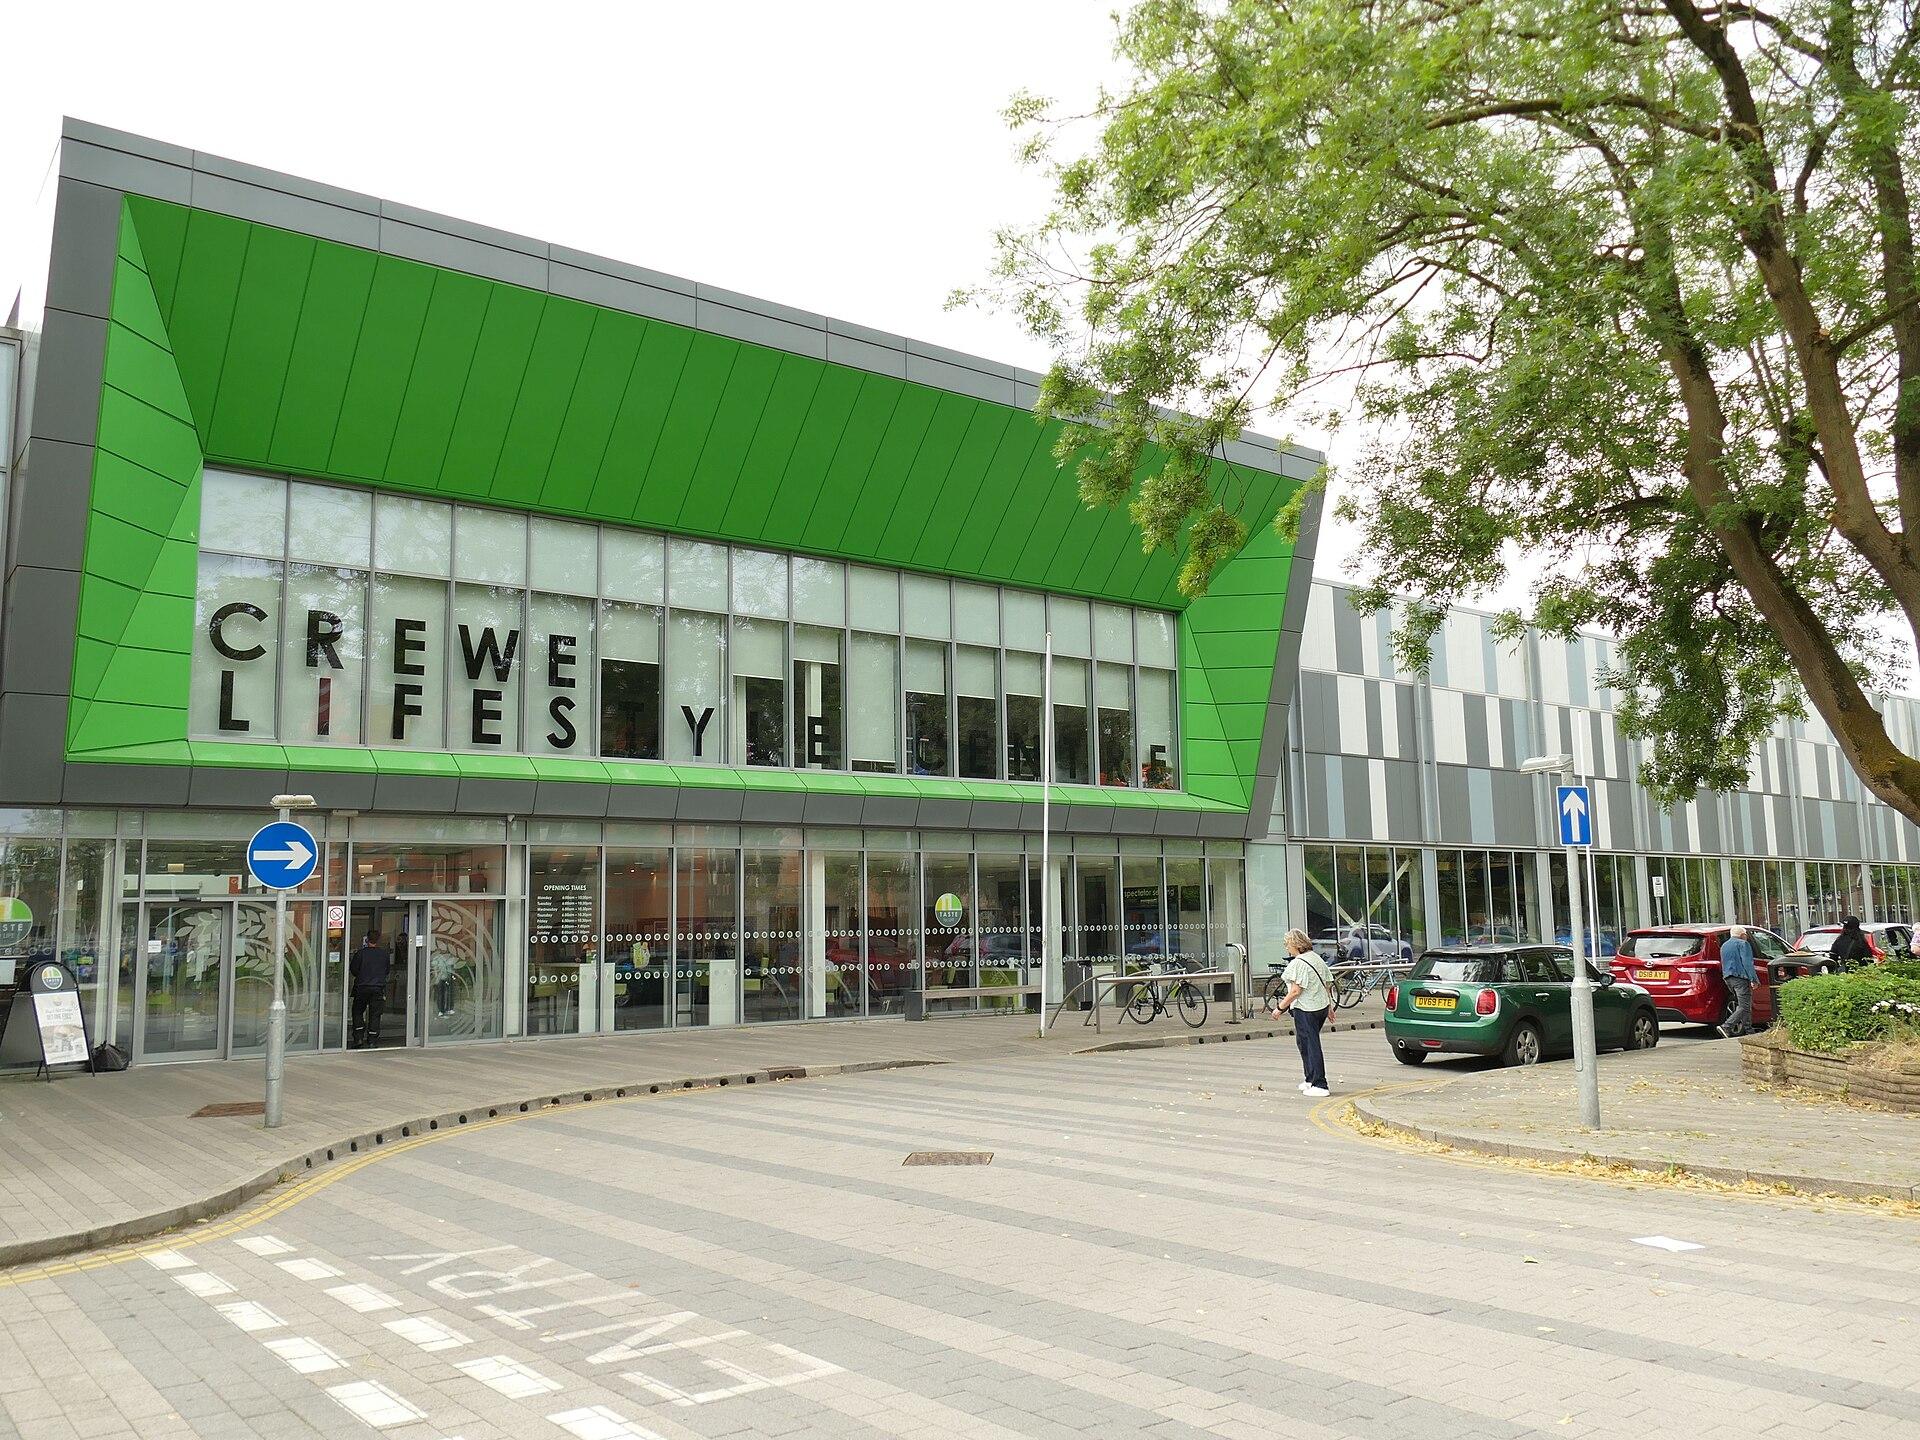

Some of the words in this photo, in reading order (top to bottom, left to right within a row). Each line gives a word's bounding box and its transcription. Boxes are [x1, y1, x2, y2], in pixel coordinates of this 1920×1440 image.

[208, 602, 577, 689] CREWE
[0, 923, 23, 932] STE
[1418, 997, 1437, 1006] DV69
[1437, 998, 1452, 1007] FTE
[369, 1244, 849, 1408] ENTRY
